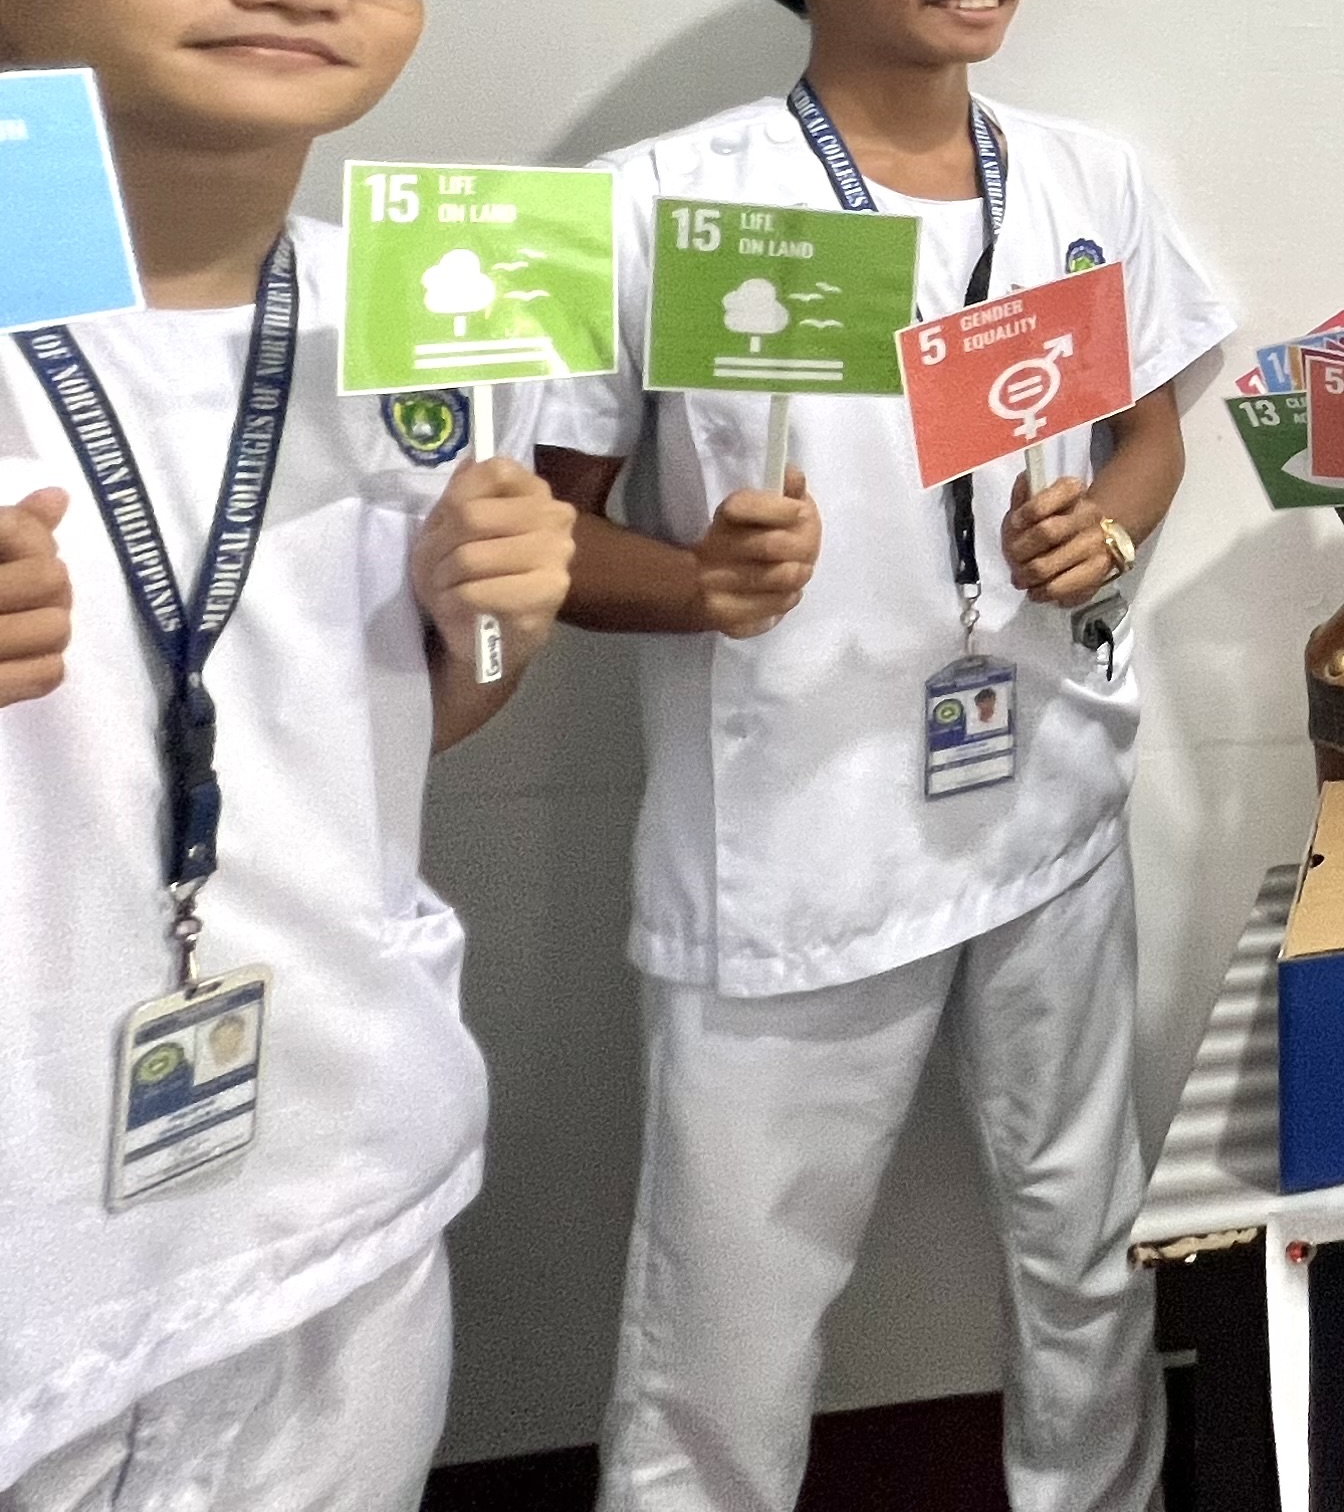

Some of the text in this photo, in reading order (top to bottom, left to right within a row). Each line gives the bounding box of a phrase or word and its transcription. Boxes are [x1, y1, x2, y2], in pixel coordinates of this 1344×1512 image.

[438, 175, 477, 195] LIFE
[817, 134, 869, 208] COLLEGES
[364, 173, 420, 223] 15
[438, 204, 517, 223] ON LAND
[672, 207, 721, 251] 15
[740, 212, 775, 231] LIFE
[739, 239, 814, 259] ON LAND
[255, 283, 292, 377] NORTHERN
[960, 299, 1024, 331] GENDER
[963, 315, 1037, 352] EQUALITY
[918, 325, 947, 366] 5
[251, 380, 281, 410] OF
[1325, 367, 1344, 394] 5
[1239, 399, 1281, 428] 13
[32, 334, 183, 633] OF NORTHERN PHILIPPINES
[226, 414, 275, 523] COLLEGES
[199, 528, 250, 632] MEDICAL
